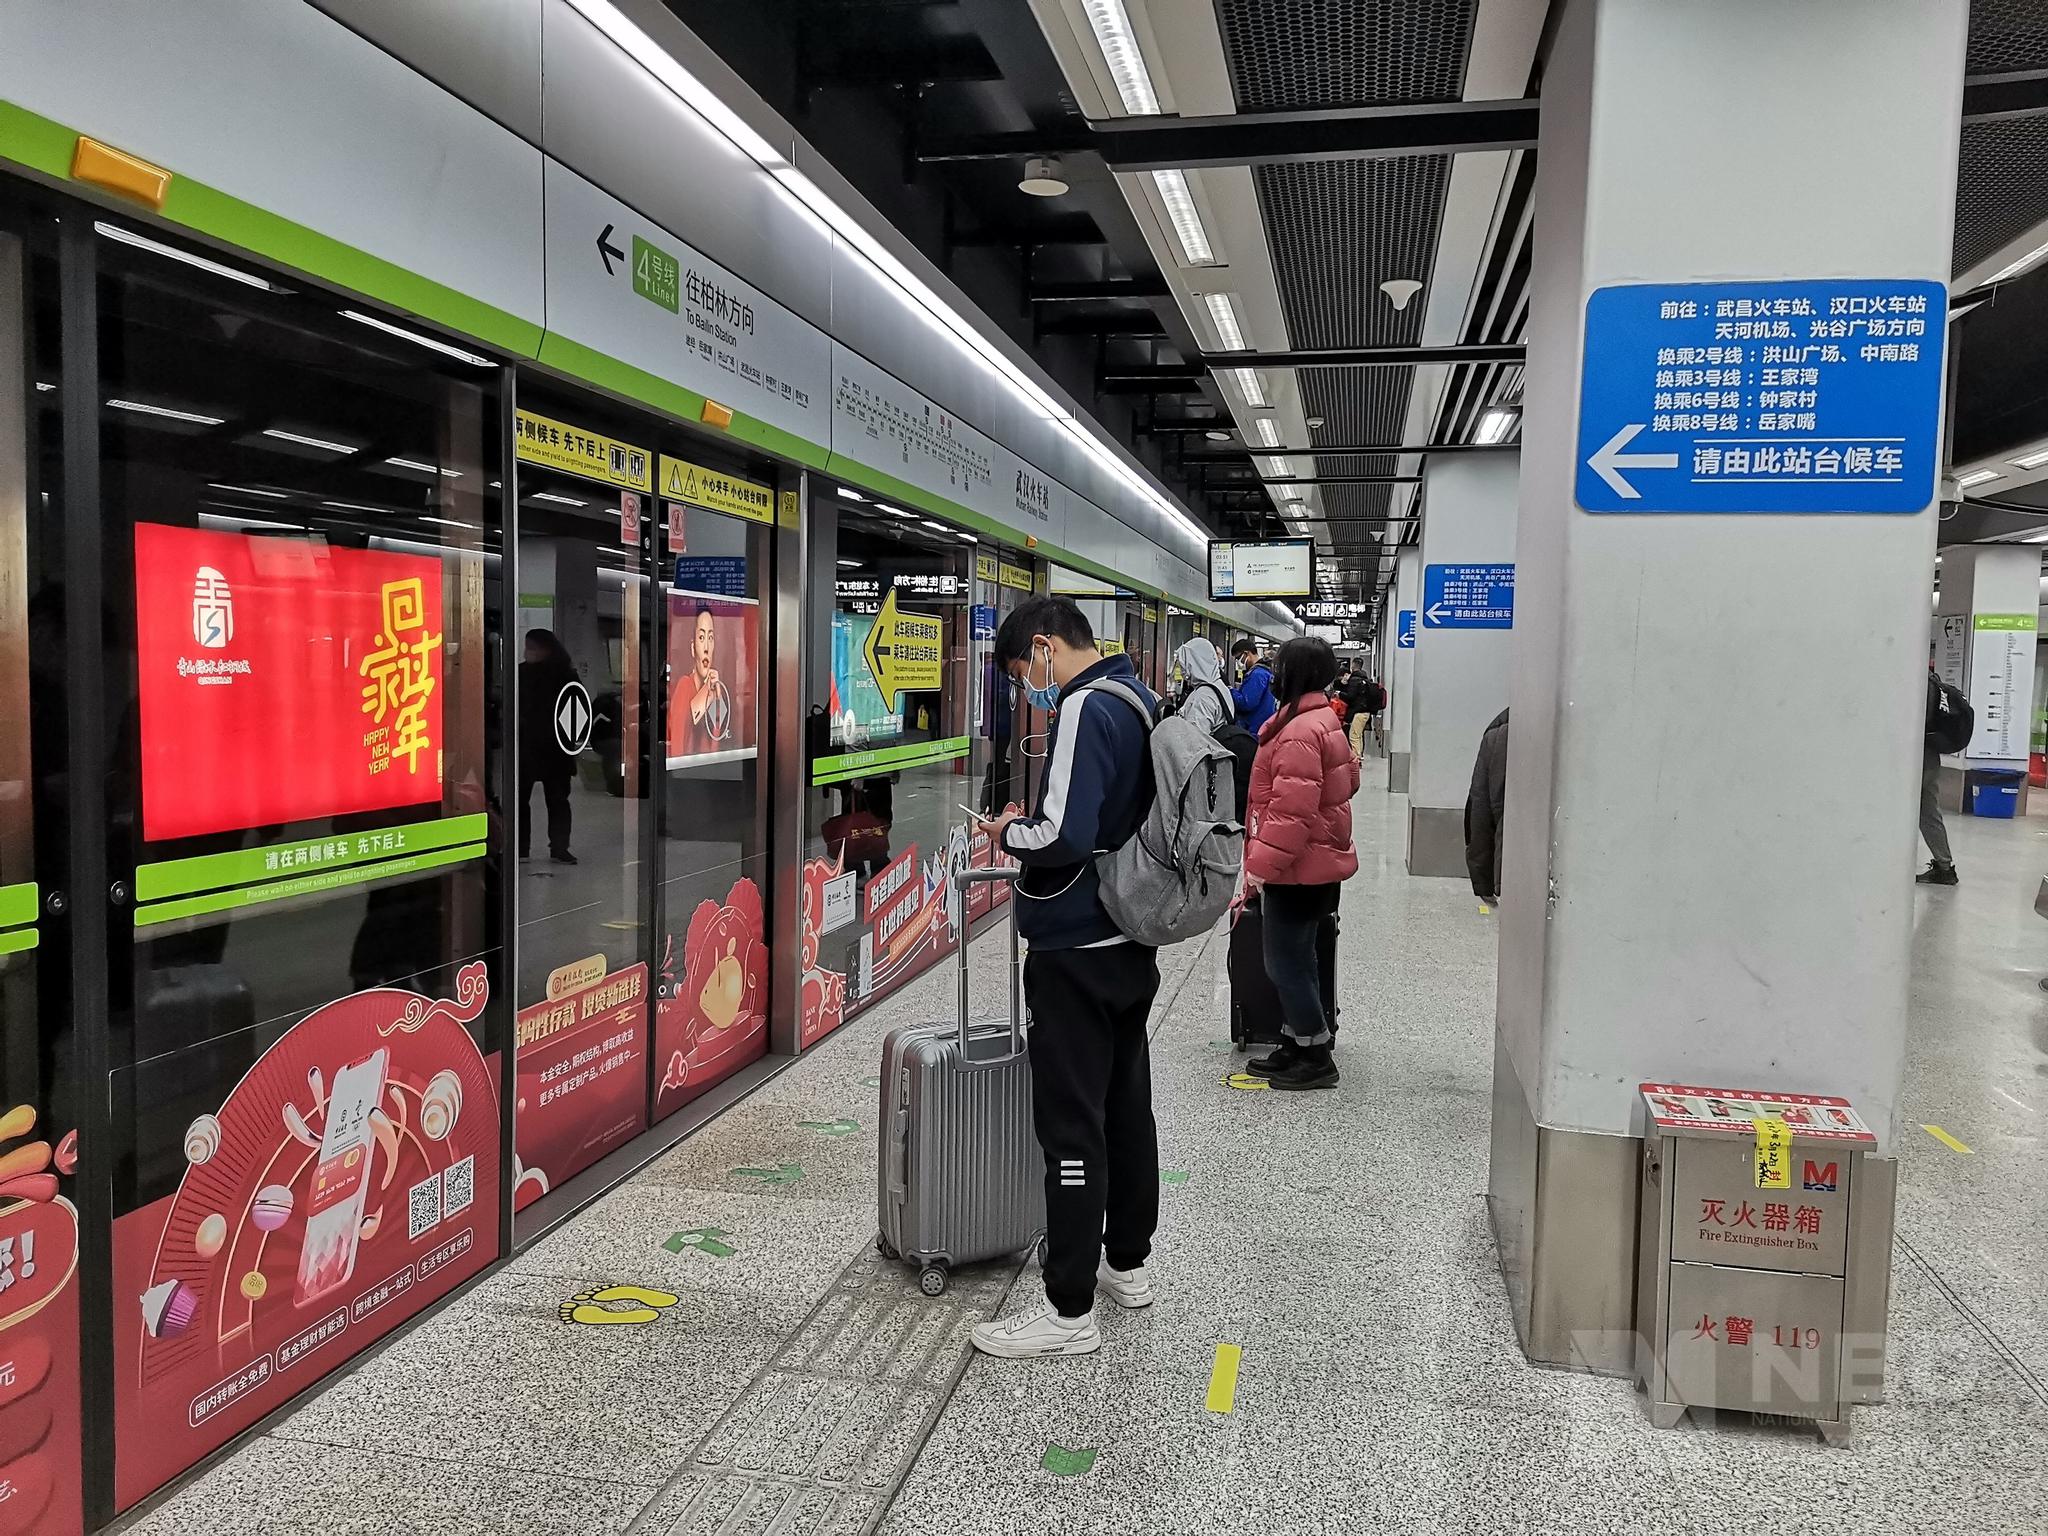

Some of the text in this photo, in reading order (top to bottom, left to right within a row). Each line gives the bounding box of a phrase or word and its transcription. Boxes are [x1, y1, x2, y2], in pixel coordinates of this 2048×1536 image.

[685, 268, 754, 336] 往柏林方向
[686, 308, 737, 347] To Bailin Station
[1715, 318, 1926, 340] 天河机场、光谷广场方向
[1655, 367, 1820, 389] 换乘3号线：王家湾
[1653, 390, 1819, 411] 换乘6号线：钟家村
[1652, 412, 1817, 432] 换乘8号线：岳家嘴
[564, 431, 605, 461] 先下后上
[1692, 447, 1903, 475] 请由此站台候车
[702, 475, 729, 496] 小心夹手
[1016, 469, 1049, 511] 武汉火车站
[1454, 609, 1512, 618] 请由此站台候车
[363, 726, 390, 747] HAPPY
[372, 741, 390, 760] NEW
[368, 757, 390, 776] YEAR
[265, 831, 406, 870] 请在两侧候车 先下后上
[246, 888, 270, 900] Please
[581, 972, 641, 1021] 投资新选择
[1698, 1199, 1824, 1235] 灭火器箱
[1699, 1228, 1819, 1251] Fire Extinguisher Box
[195, 1234, 471, 1420] 国内转账全免费 基金理财智能选 跨境金融一站式 生活专区享乐购
[1691, 1313, 1821, 1351] 火警 119
